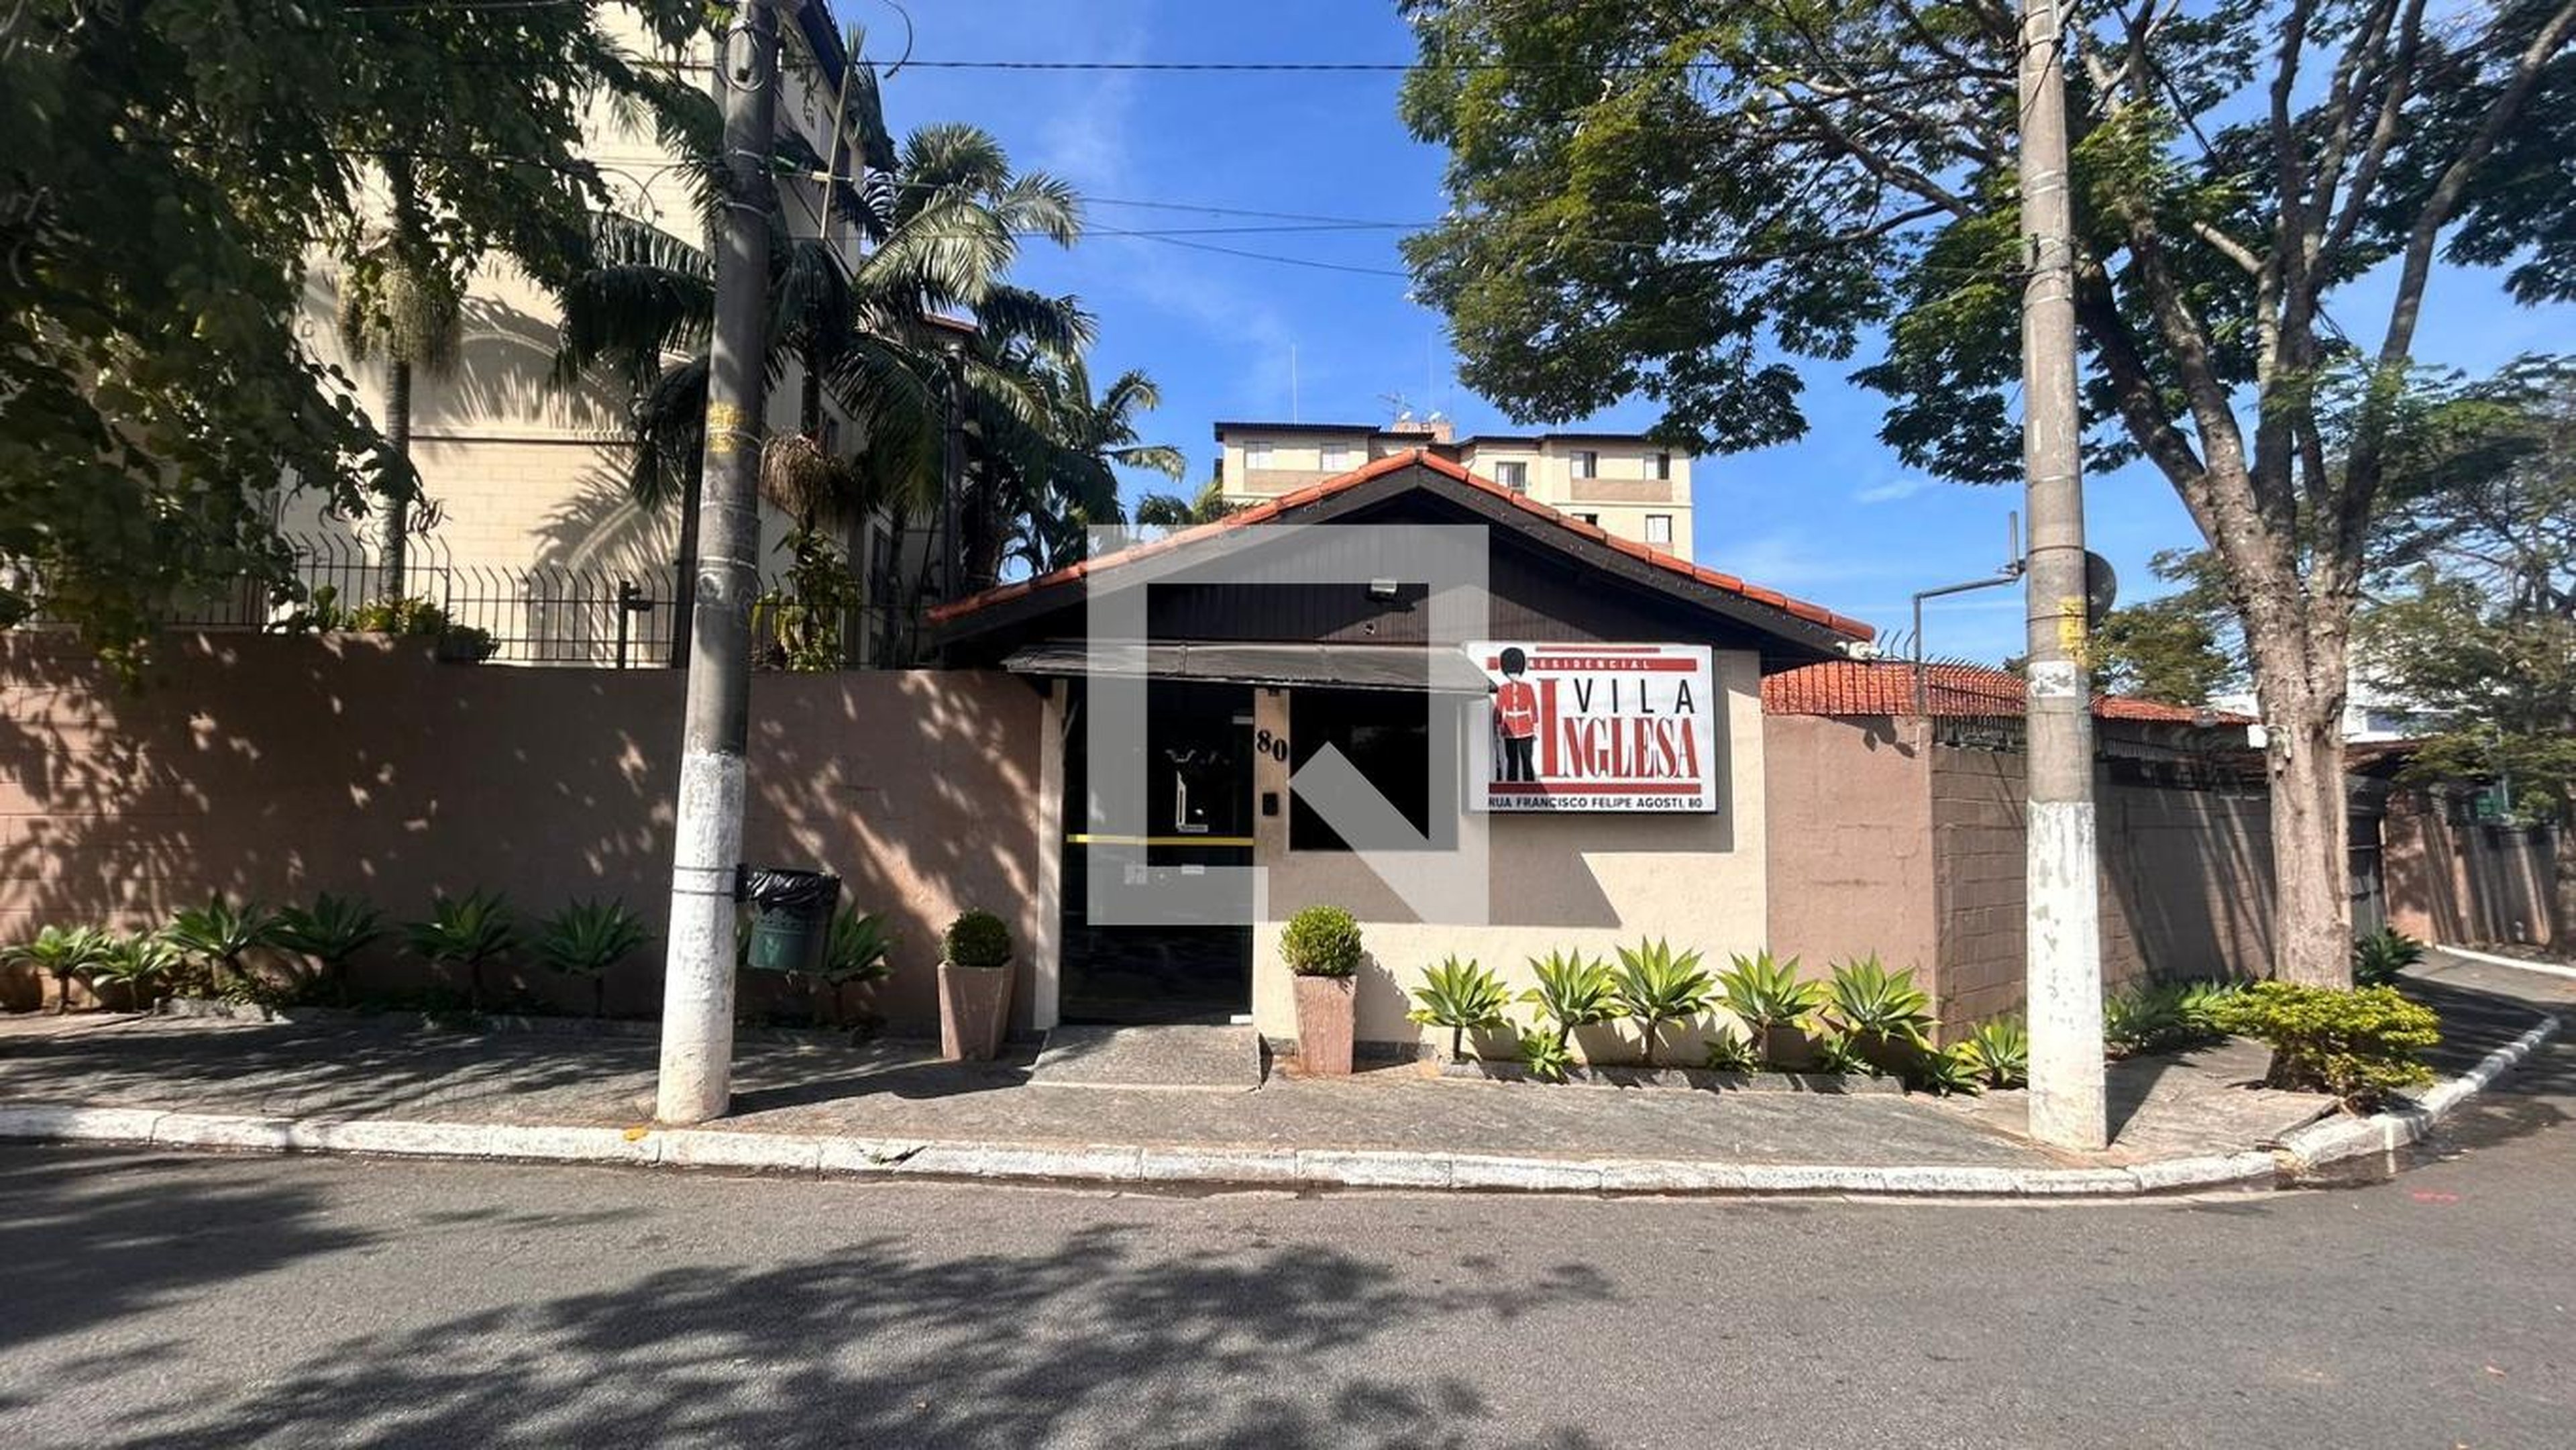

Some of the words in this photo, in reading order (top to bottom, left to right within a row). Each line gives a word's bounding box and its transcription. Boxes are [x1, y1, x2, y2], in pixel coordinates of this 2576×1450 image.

[1528, 660, 1650, 669] RESIDENCIAL
[1574, 678, 1695, 714] VILA
[1537, 678, 1699, 778] INGLESA
[1257, 730, 1287, 762] 80
[1489, 797, 1513, 809] RUA
[1516, 797, 1588, 809] FRANCISCO
[1592, 797, 1631, 809] FELIPE
